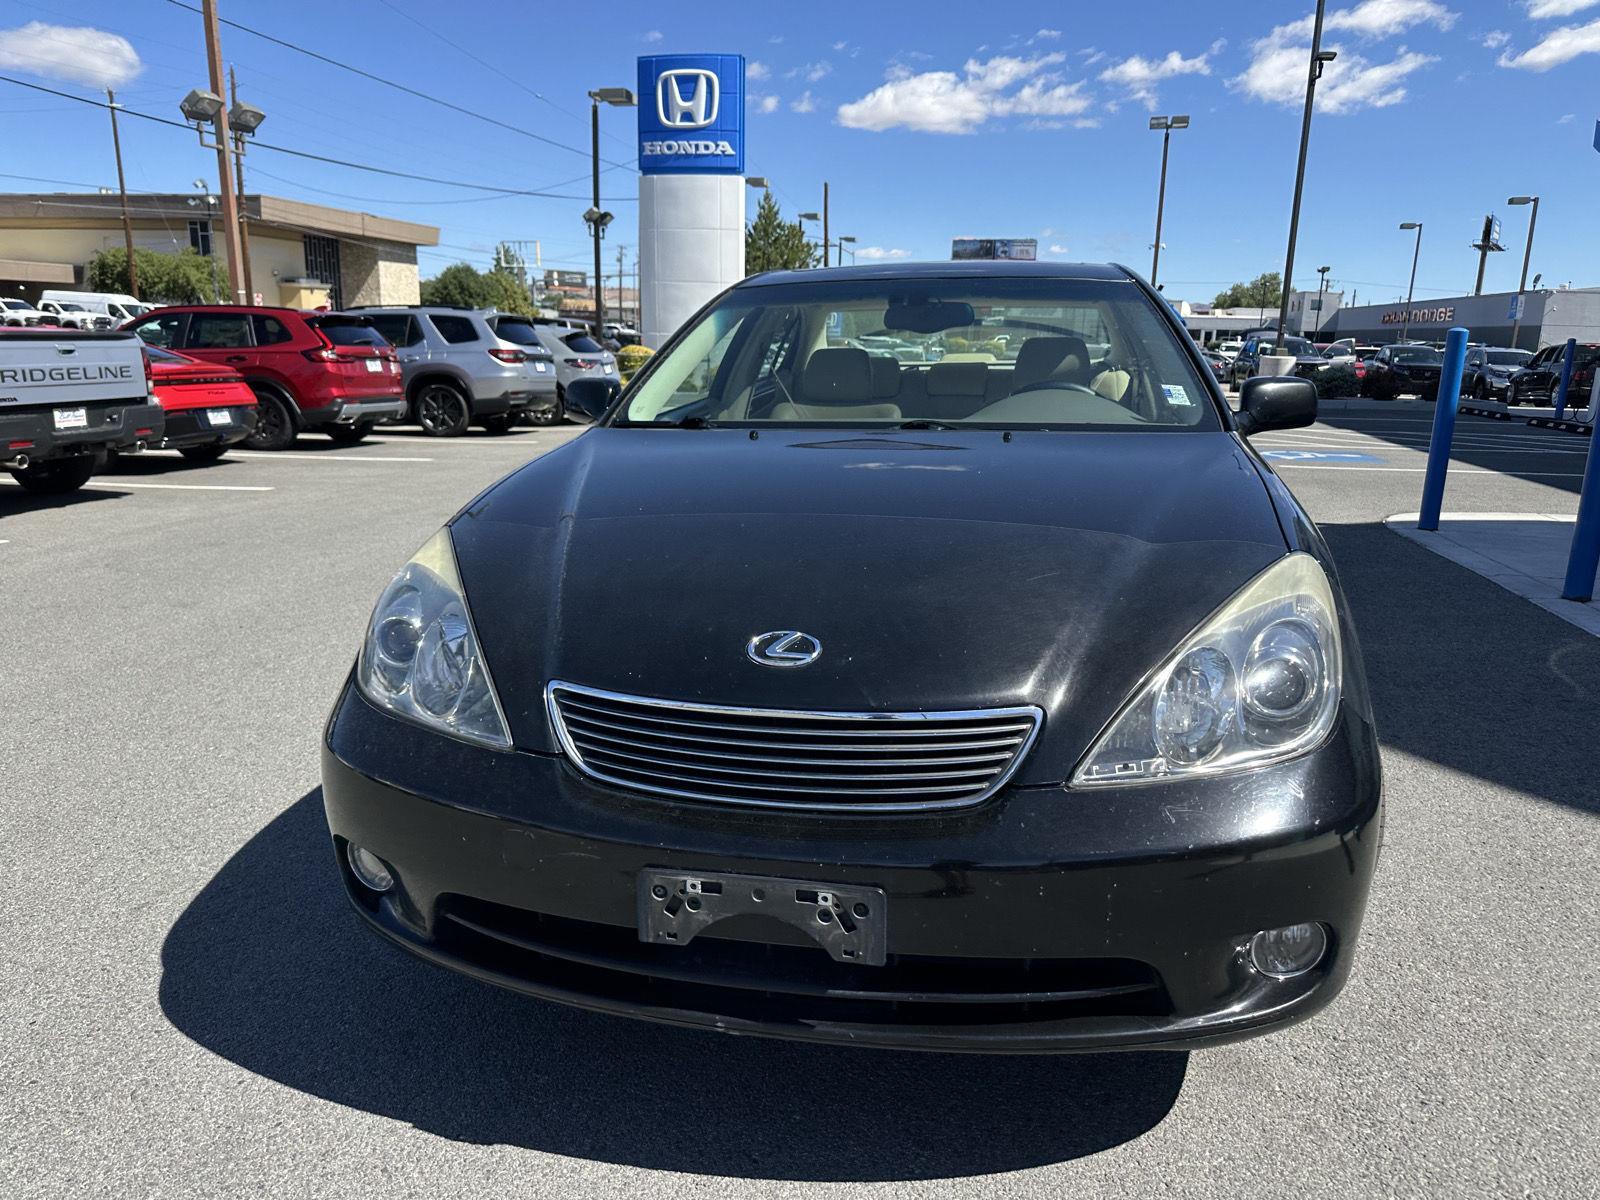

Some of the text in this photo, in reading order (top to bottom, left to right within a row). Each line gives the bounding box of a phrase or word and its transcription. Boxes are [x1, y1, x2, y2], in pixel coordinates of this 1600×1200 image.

[642, 140, 736, 156] HONDA
[1412, 306, 1454, 322] DODGE
[0, 365, 133, 384] RIDGELINE
